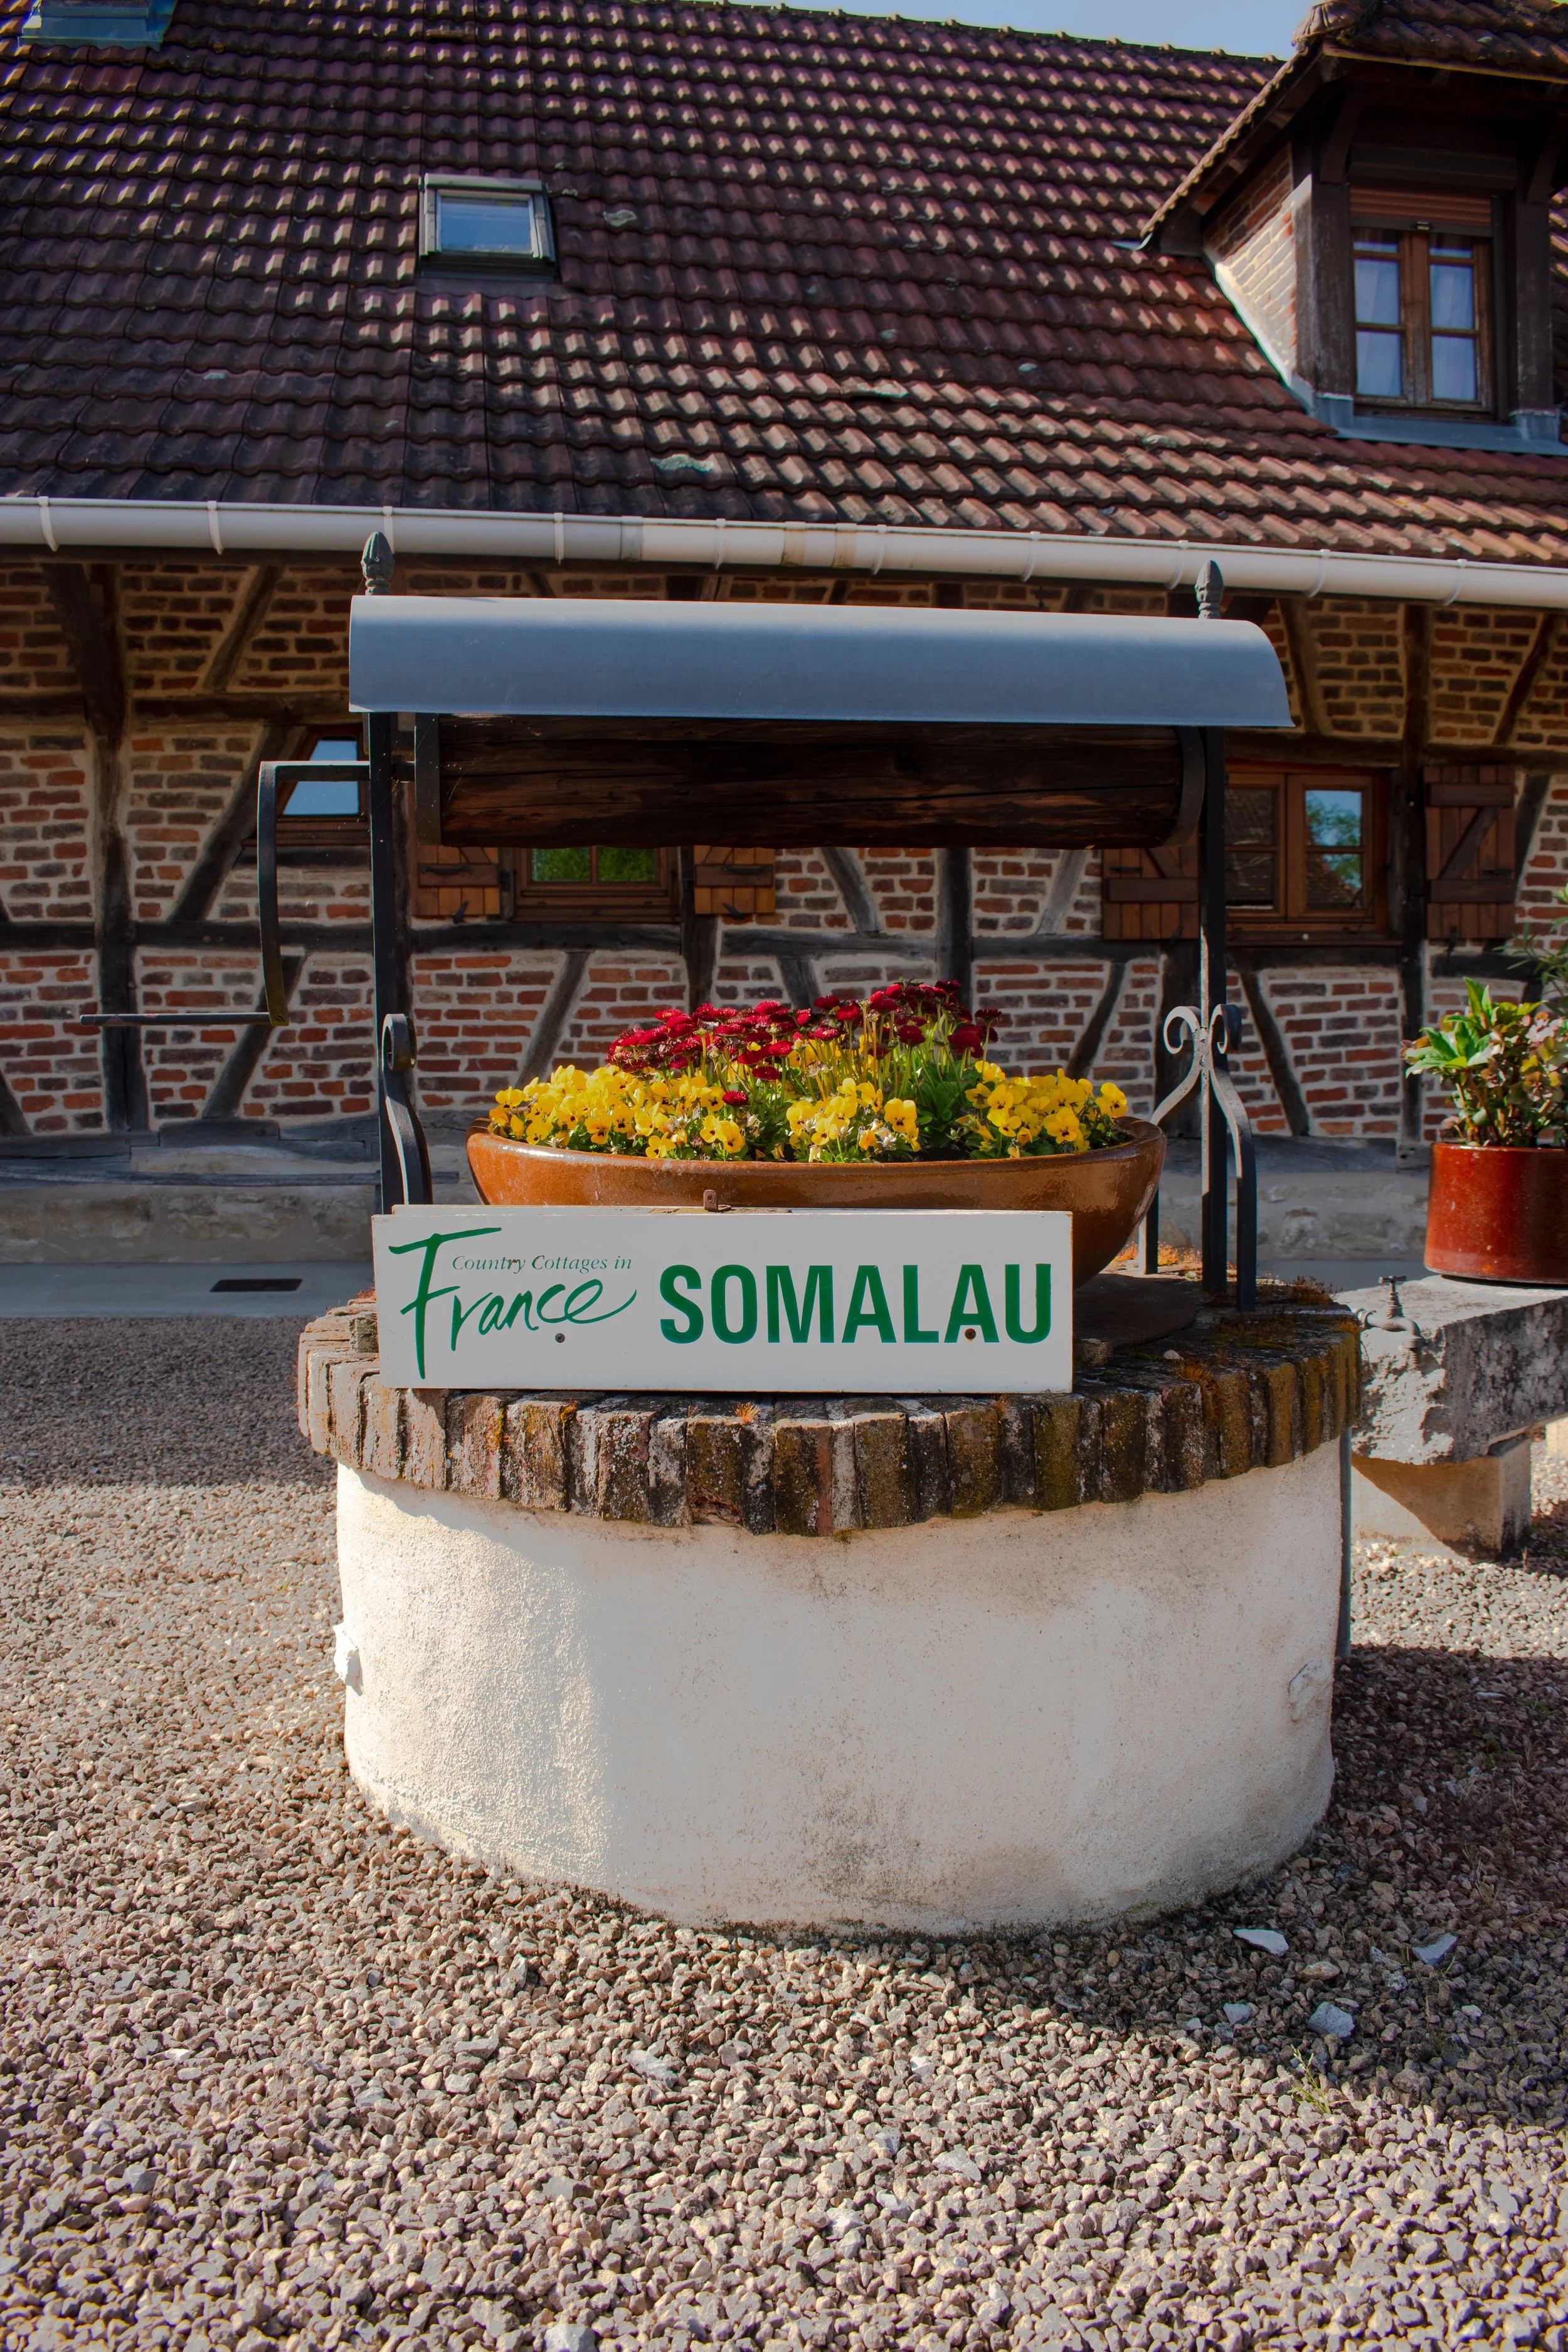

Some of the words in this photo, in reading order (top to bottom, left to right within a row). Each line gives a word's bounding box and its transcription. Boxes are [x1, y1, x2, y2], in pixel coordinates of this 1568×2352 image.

[388, 1227, 637, 1380] France
[452, 1255, 526, 1274] Country
[532, 1255, 608, 1274] Cottages
[615, 1255, 632, 1270] in
[659, 1263, 1052, 1344] SOMALAU
